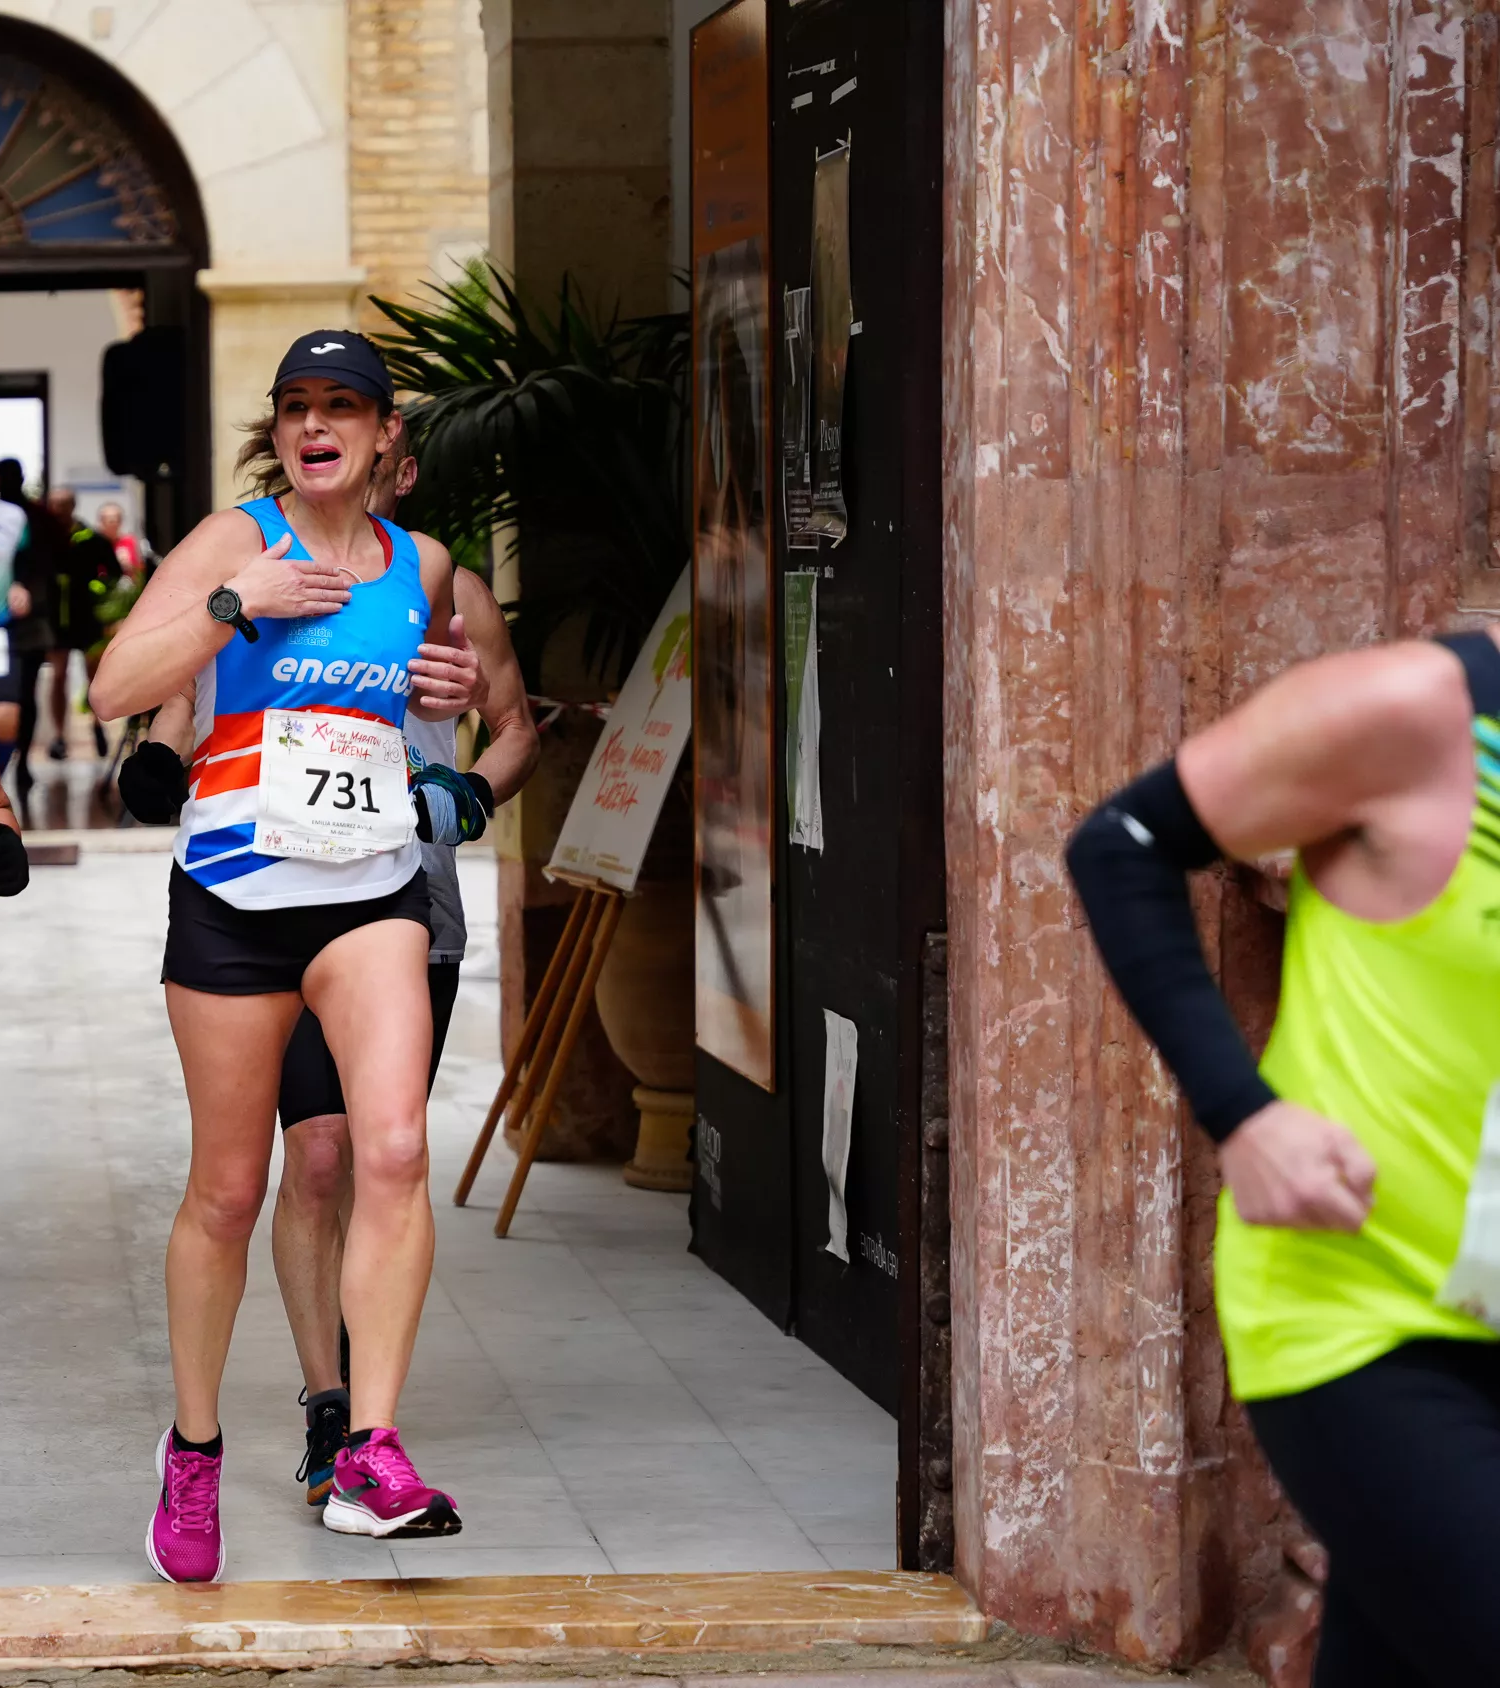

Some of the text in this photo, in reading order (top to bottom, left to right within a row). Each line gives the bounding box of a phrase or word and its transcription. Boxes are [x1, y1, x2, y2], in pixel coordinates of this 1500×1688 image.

[287, 636, 330, 647] Lucena
[330, 740, 372, 761] LUCENA
[305, 768, 380, 814] 731
[860, 1231, 887, 1273] ENTRADA
